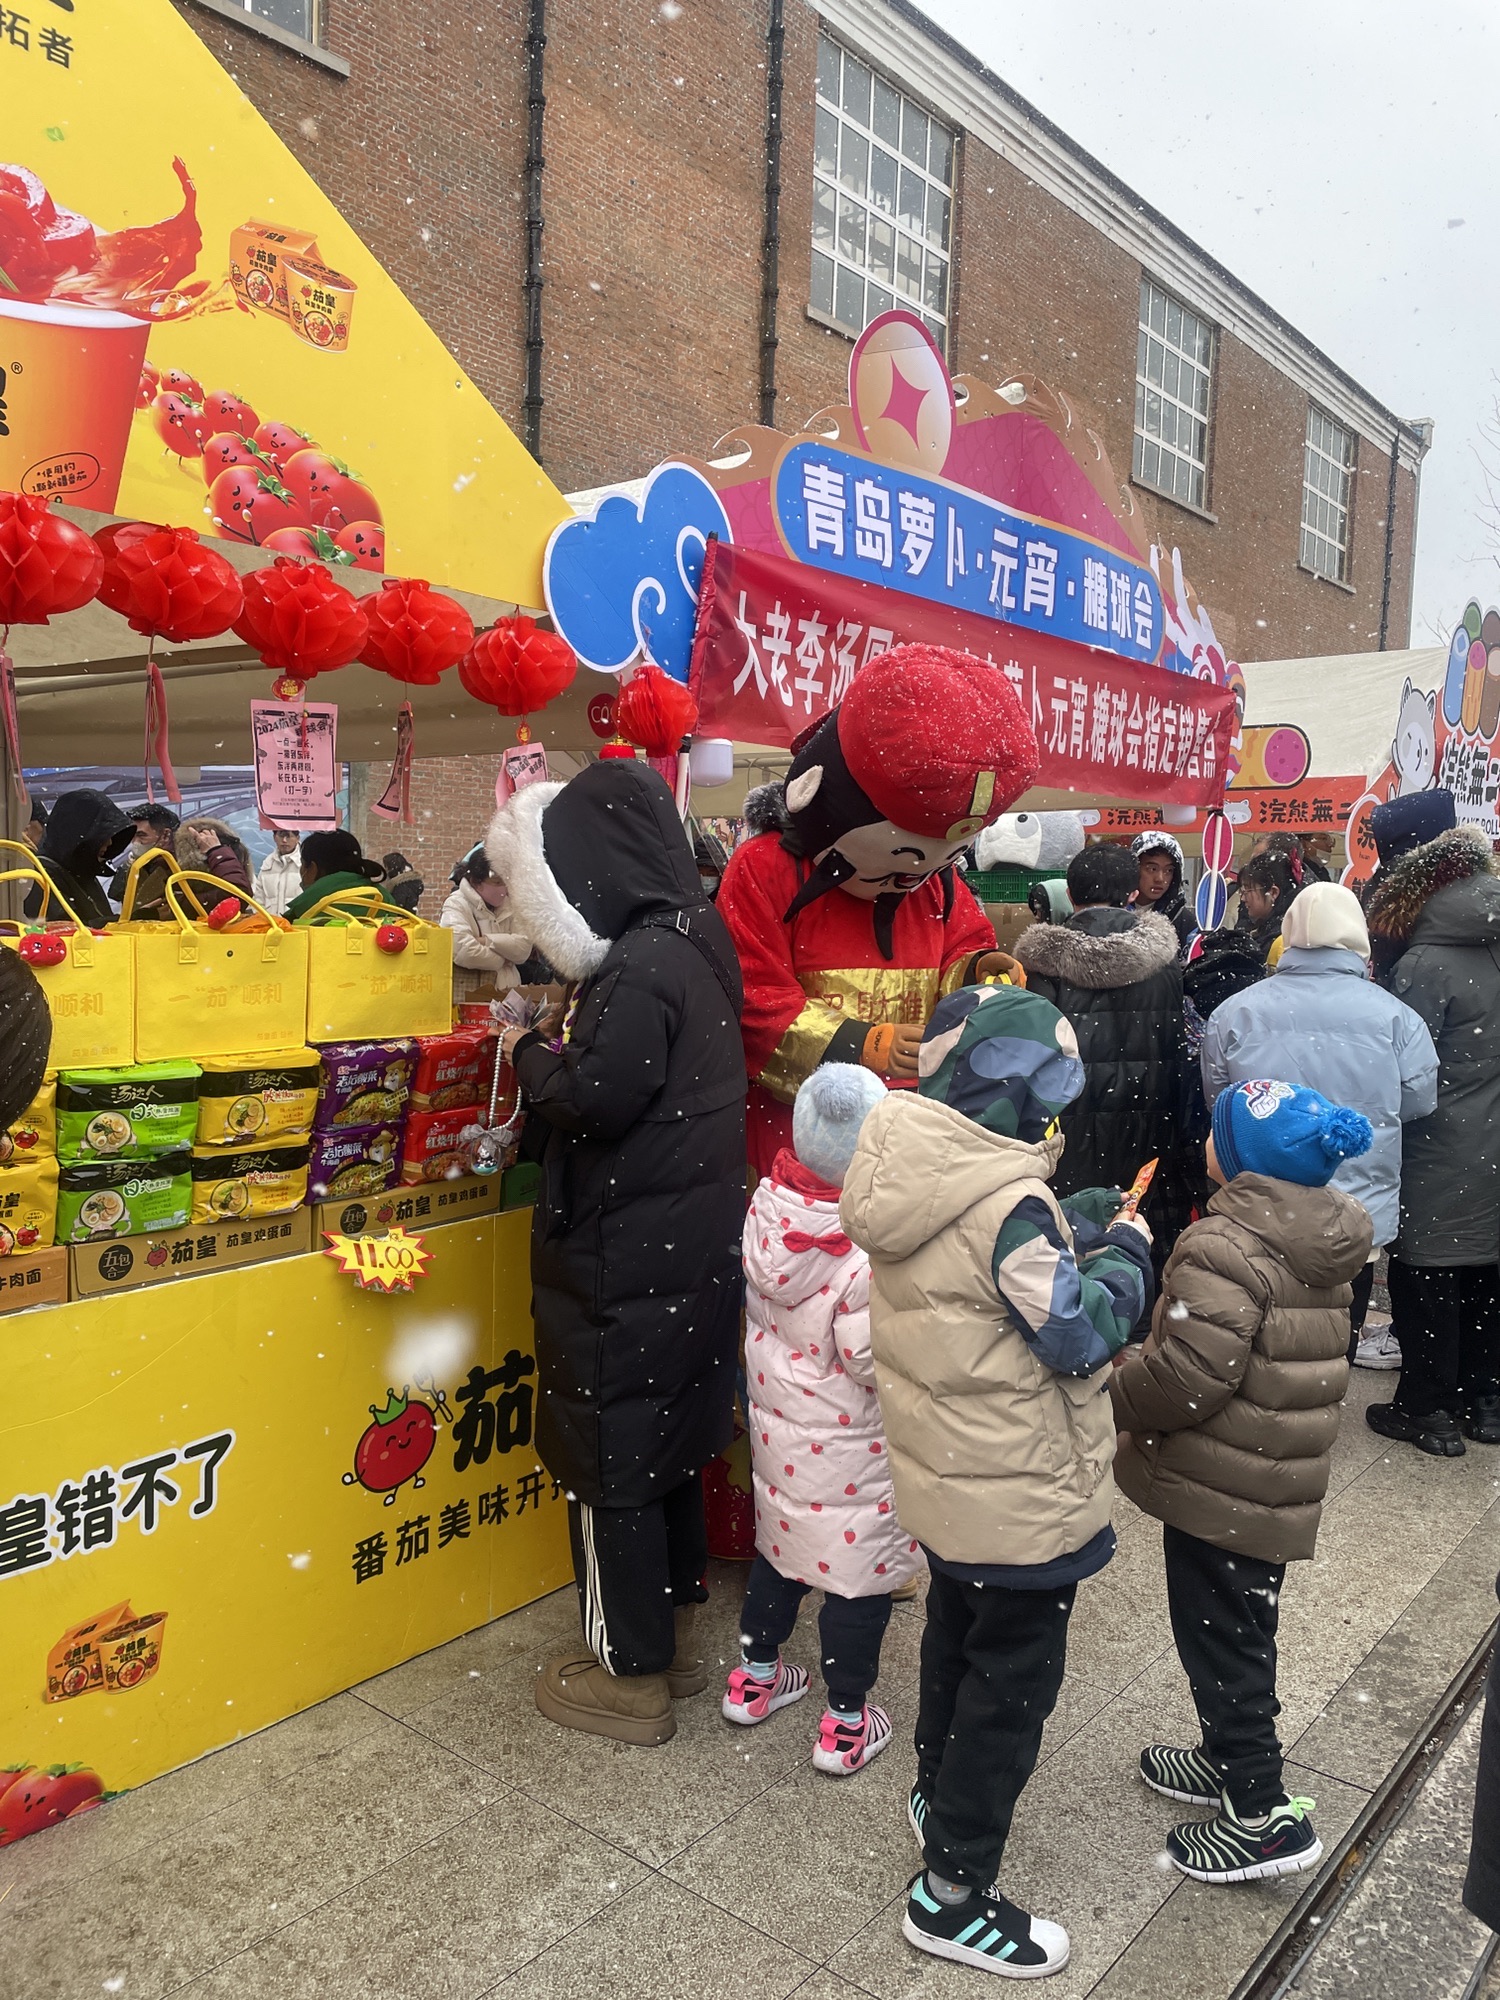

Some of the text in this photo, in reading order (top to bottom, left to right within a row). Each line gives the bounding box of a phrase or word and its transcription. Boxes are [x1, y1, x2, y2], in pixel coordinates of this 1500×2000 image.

[256, 249, 278, 268] 茄皇
[313, 289, 336, 309] 茄皇
[111, 1084, 164, 1104] 汤达人
[0, 1192, 20, 1210] 皇
[396, 1184, 488, 1221] 茄皇 茄皇鸡蛋面
[171, 1222, 292, 1265] 茄皇 茄皇鸡蛋面
[103, 1251, 130, 1267] 五包
[353, 1242, 414, 1269] 11.00
[107, 1267, 126, 1279] 合一
[453, 1349, 535, 1472] 茄
[0, 1433, 232, 1575] 皇错不了
[352, 1469, 564, 1584] 番茄美味开
